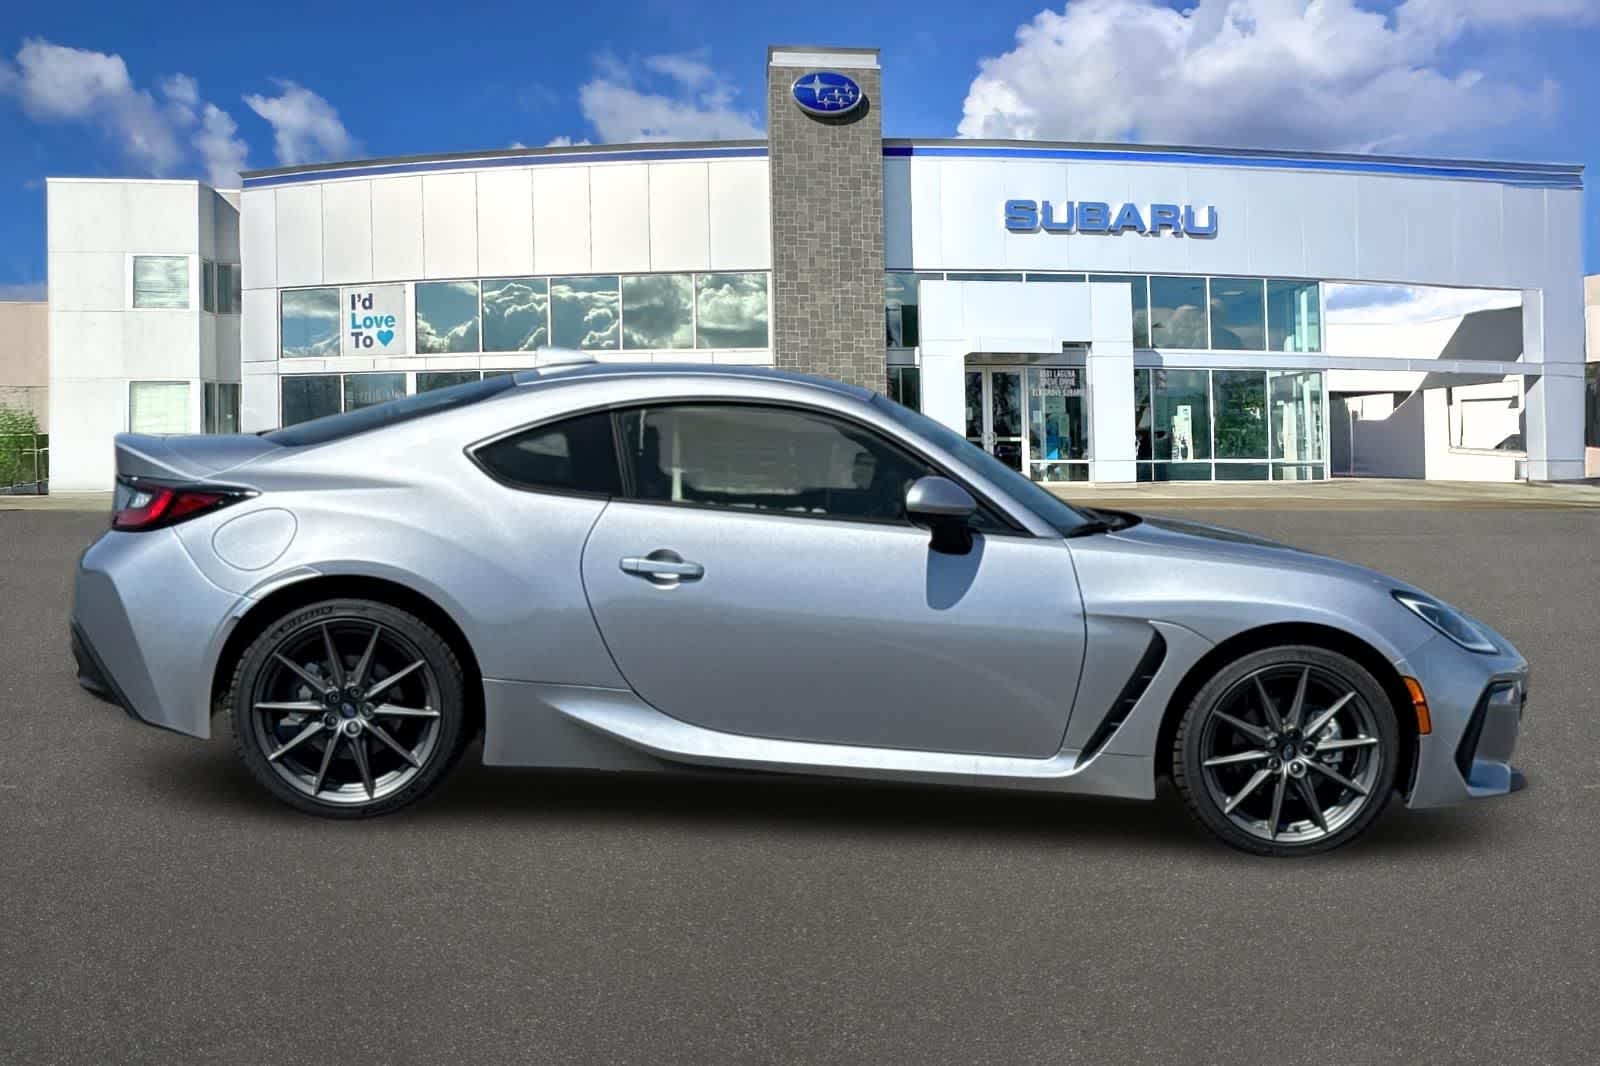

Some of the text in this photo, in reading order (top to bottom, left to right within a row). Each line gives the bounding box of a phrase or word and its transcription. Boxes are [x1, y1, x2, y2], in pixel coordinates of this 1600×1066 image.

[1005, 199, 1217, 237] SUBARU
[351, 293, 373, 310] I'd
[351, 312, 396, 329] Love
[351, 331, 374, 349] To
